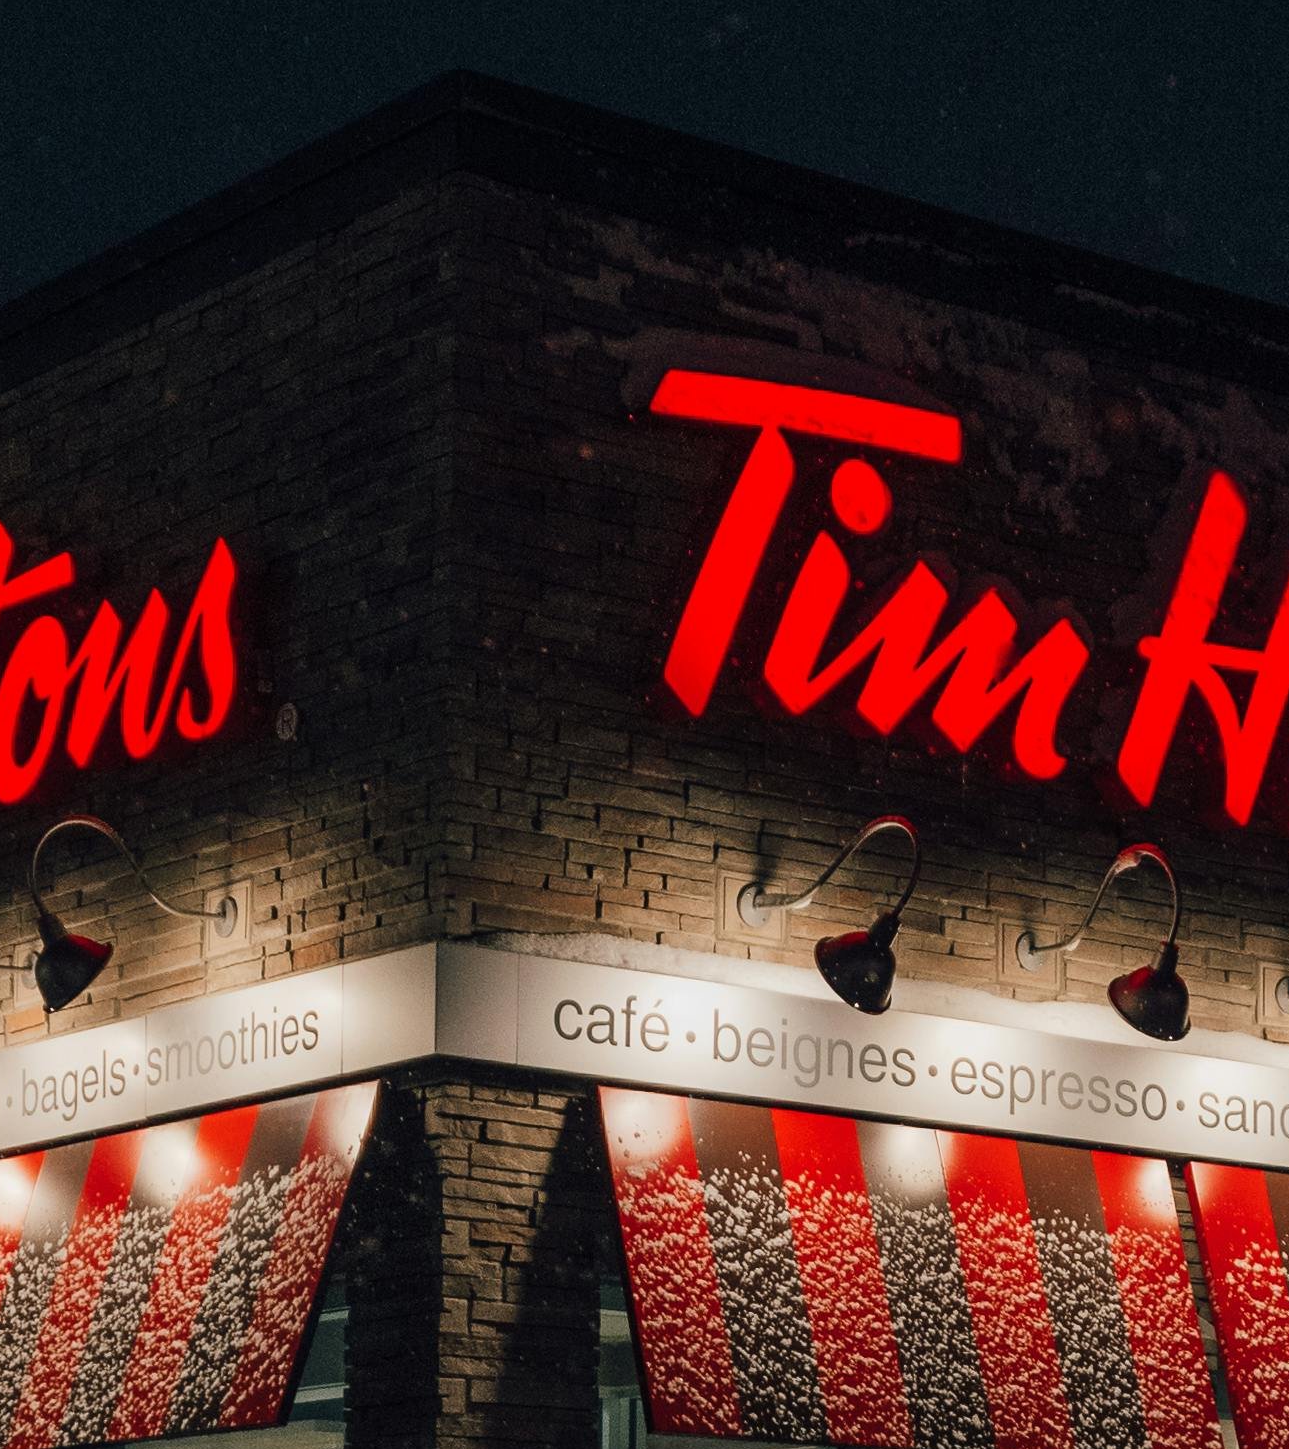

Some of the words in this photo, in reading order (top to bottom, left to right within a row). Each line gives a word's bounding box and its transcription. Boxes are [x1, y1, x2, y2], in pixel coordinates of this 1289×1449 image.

[650, 370, 1091, 780] Tim
[22, 1051, 126, 1121] bagels
[147, 1009, 319, 1085] smoothies
[554, 998, 669, 1053] café
[712, 1009, 915, 1088] beignes
[950, 1057, 1167, 1121] espresso
